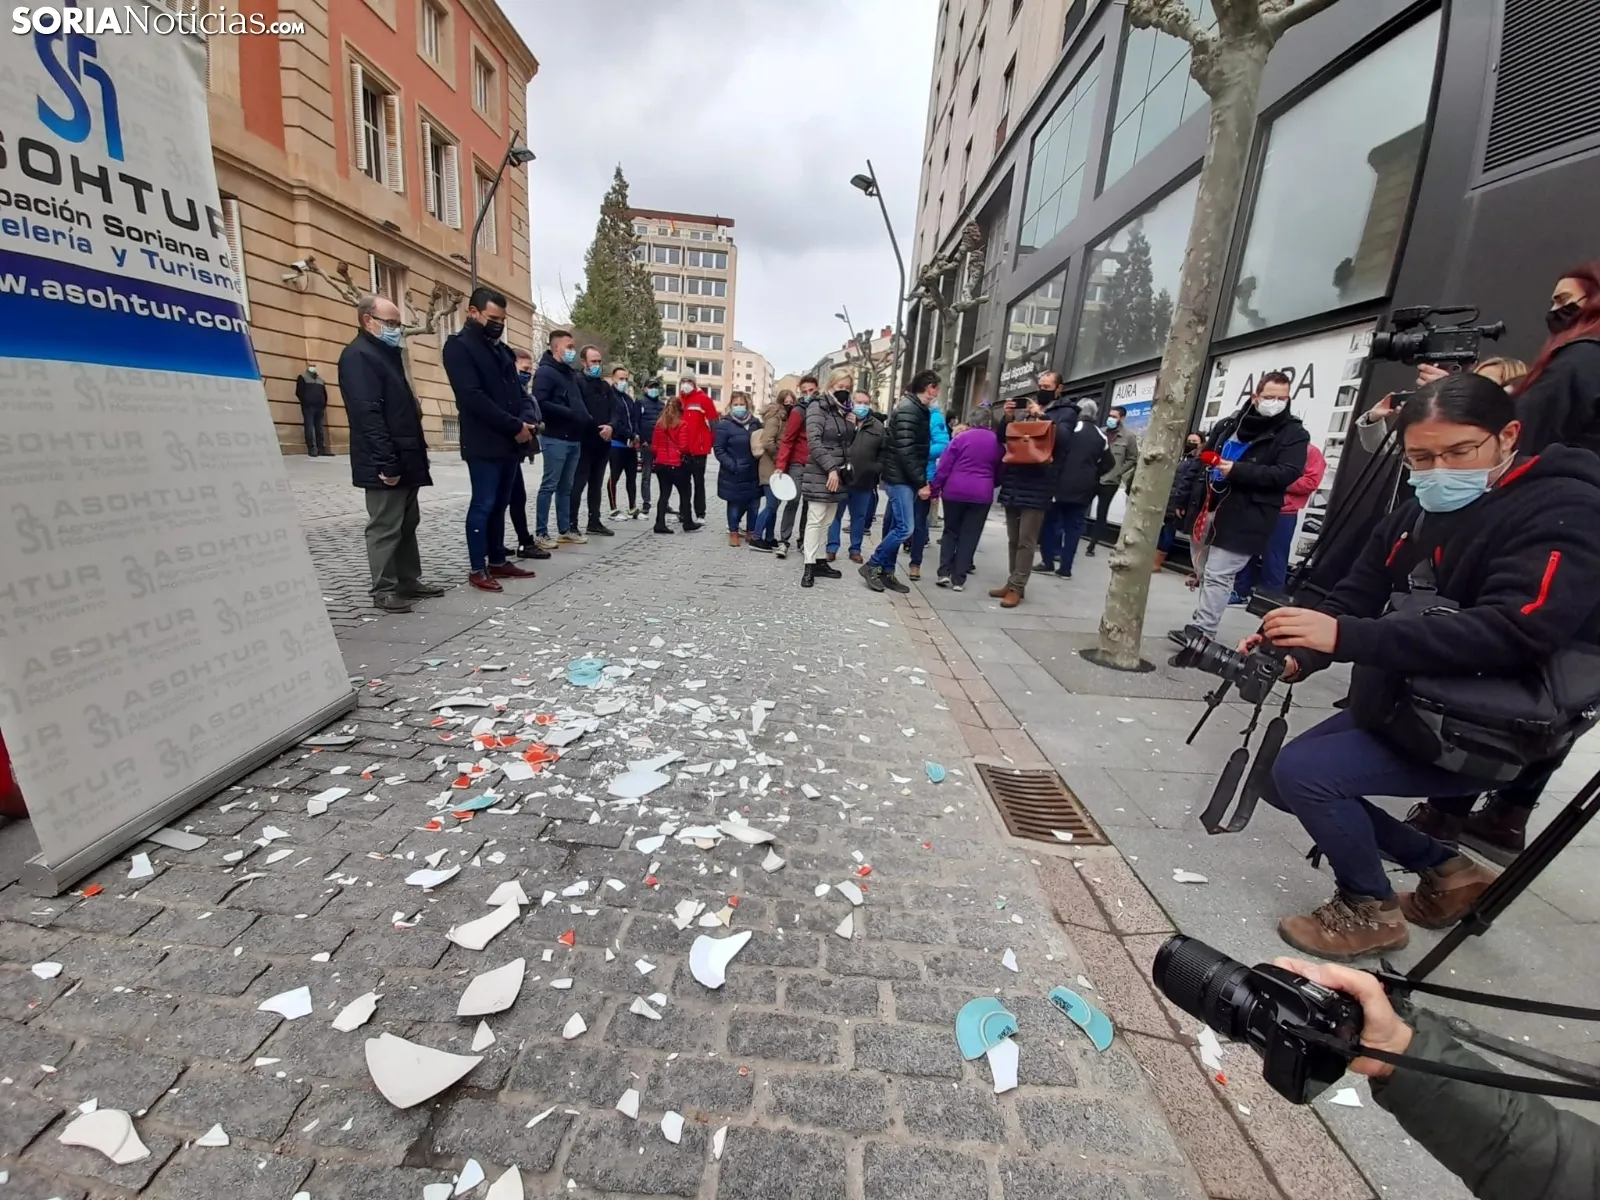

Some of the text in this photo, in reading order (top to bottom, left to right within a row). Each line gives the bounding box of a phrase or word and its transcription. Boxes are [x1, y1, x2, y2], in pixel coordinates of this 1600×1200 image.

[103, 213, 210, 262] Soriana
[111, 245, 127, 267] y
[1114, 382, 1138, 401] AURA
[52, 485, 218, 521] ASOHTUR
[154, 527, 288, 568] ASOHTUR
[22, 607, 196, 682] ASOHTUR
[122, 638, 269, 713] ASOHTUR
[188, 670, 311, 742] ASOHTUR
